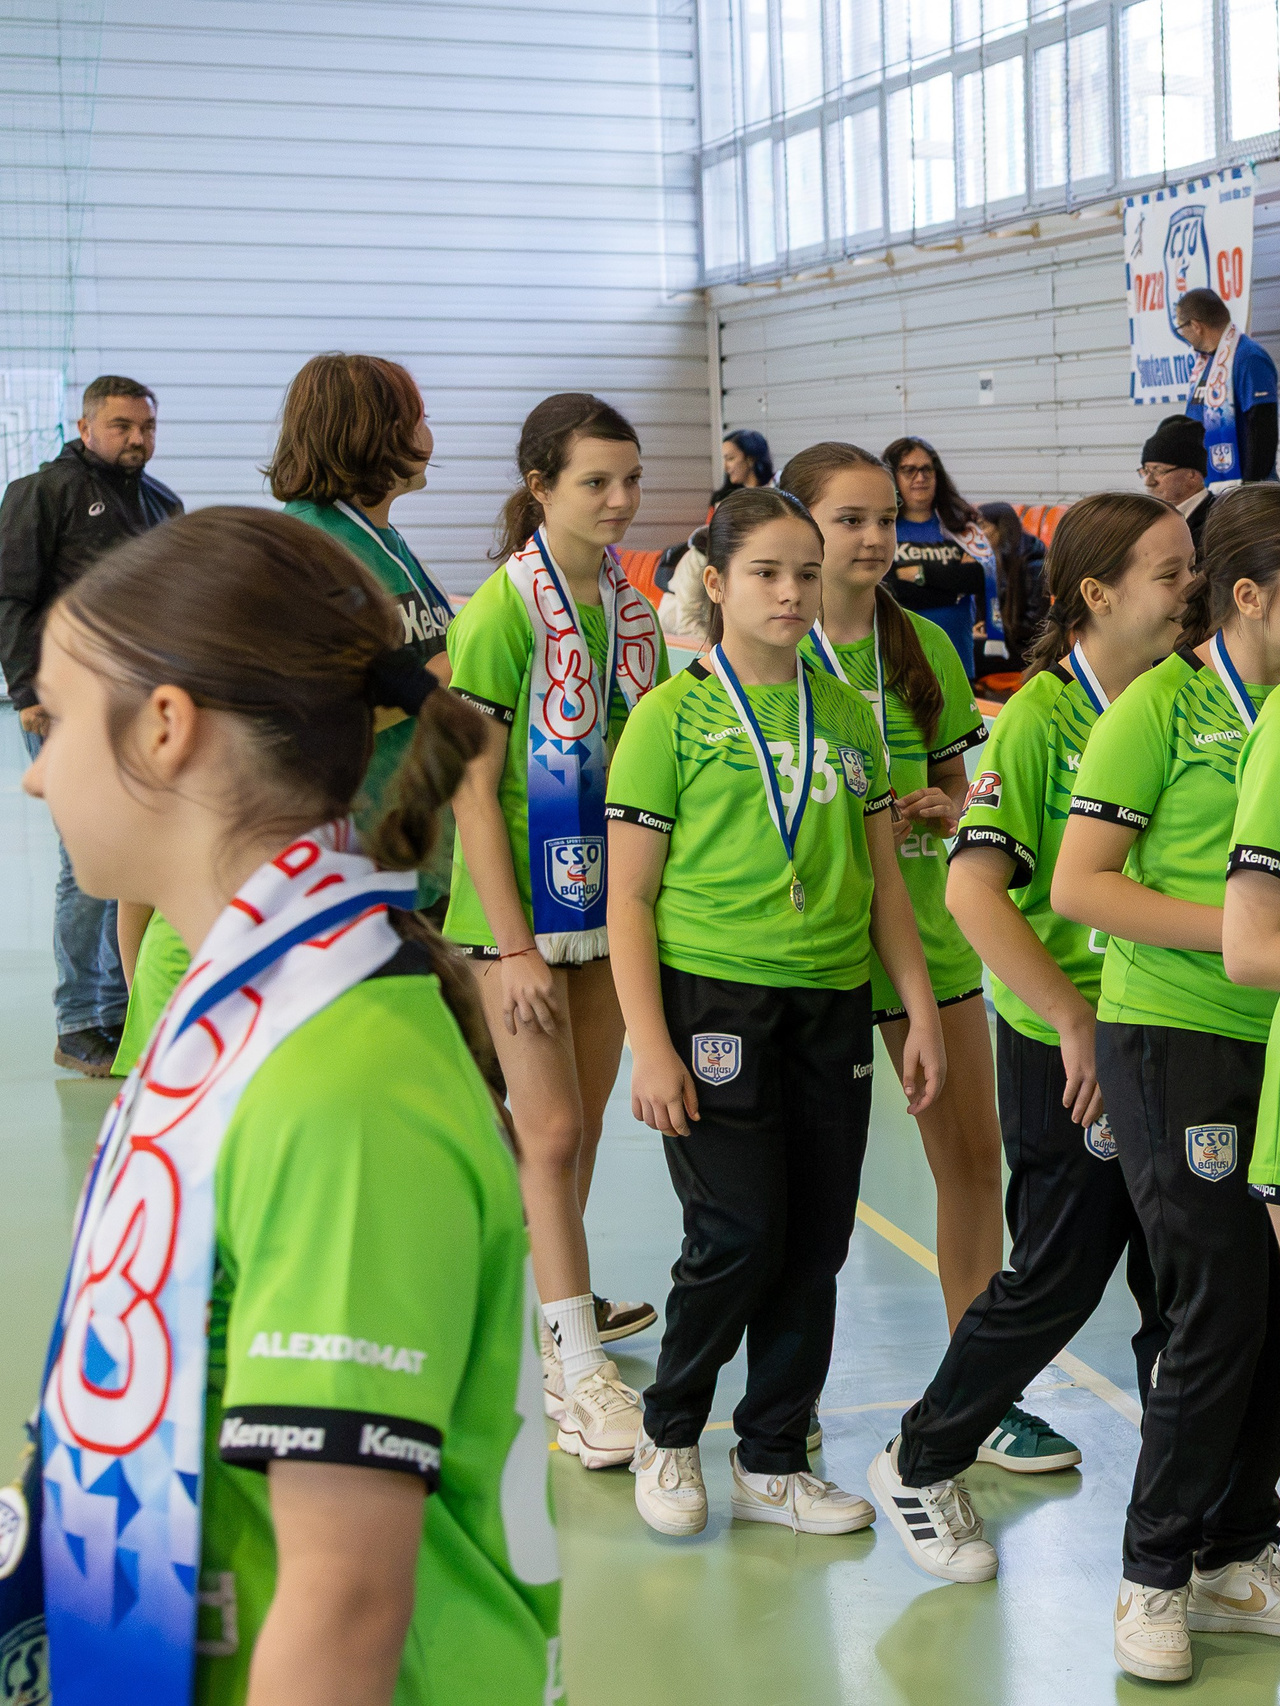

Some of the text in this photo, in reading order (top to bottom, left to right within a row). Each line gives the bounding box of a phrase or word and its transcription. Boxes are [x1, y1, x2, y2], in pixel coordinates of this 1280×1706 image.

[1193, 729, 1243, 745] Kempa
[1117, 806, 1149, 828] Kemp
[556, 845, 599, 866] CSO
[967, 829, 1036, 871] Kempa Kemp
[853, 1063, 875, 1079] Kem
[1195, 1132, 1230, 1147] CSO
[247, 1331, 428, 1375] ALEXDOMAT
[219, 1417, 325, 1456] Kempa
[4, 1640, 44, 1698] CS
